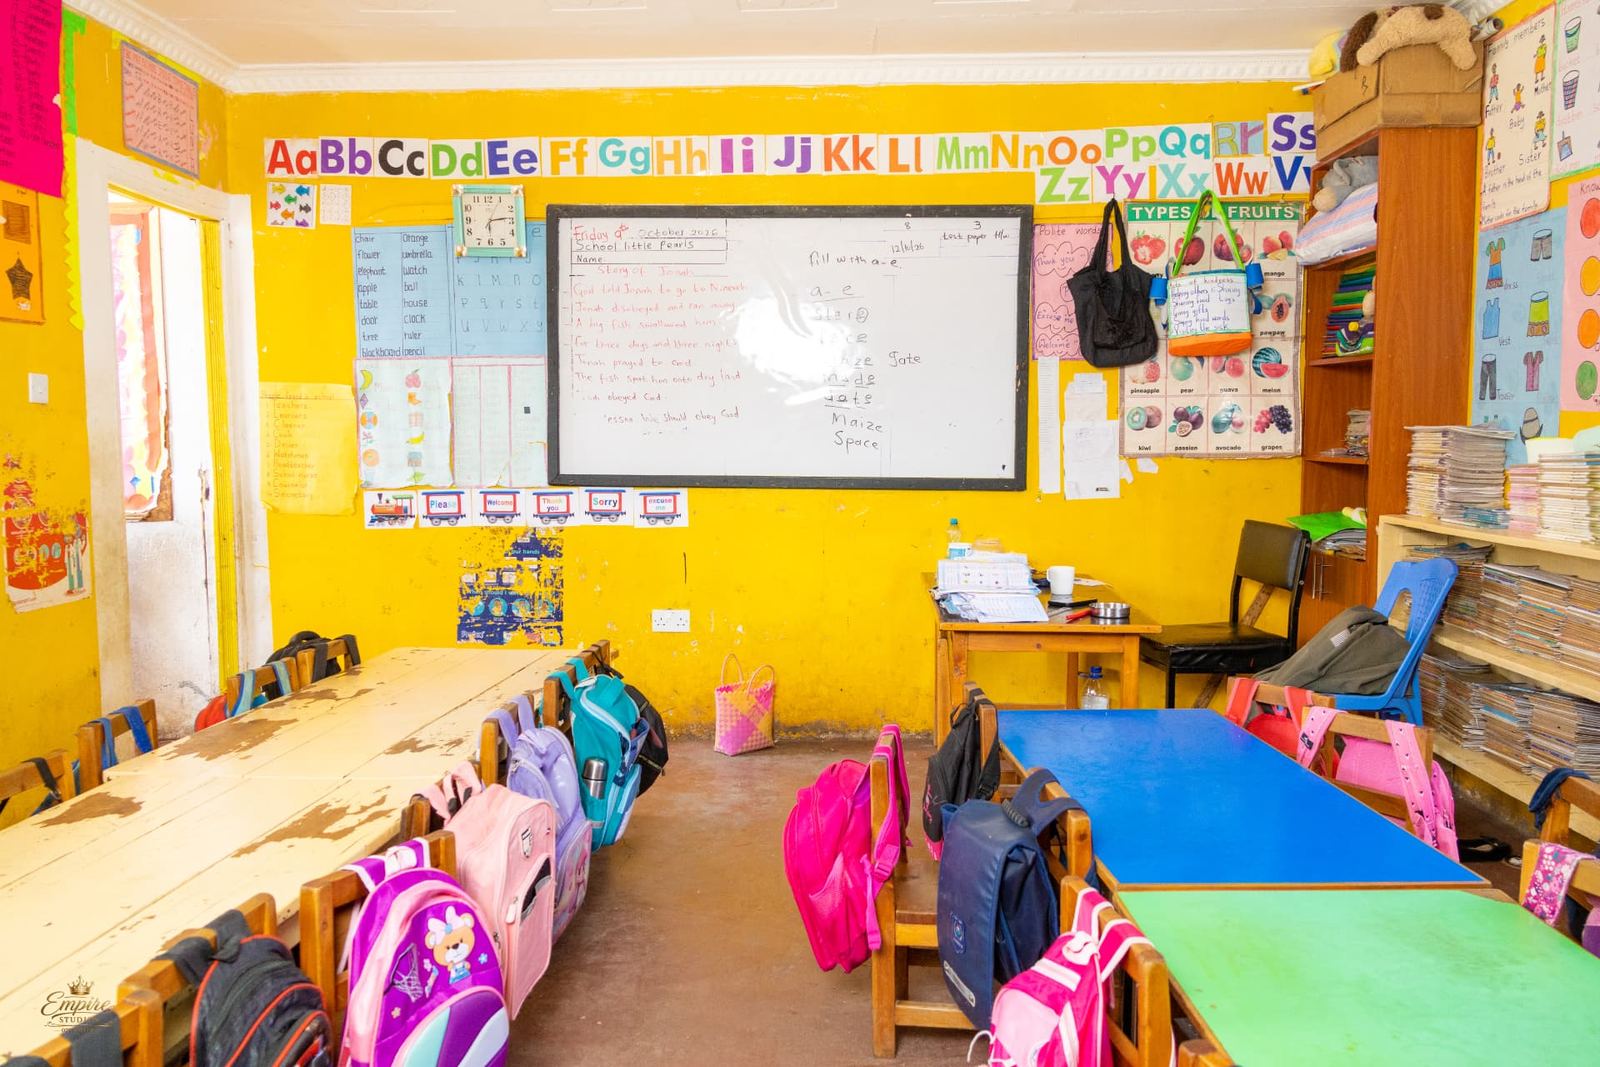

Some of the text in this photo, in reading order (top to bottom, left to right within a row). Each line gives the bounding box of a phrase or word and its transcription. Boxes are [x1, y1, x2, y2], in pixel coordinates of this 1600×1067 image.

[267, 139, 317, 175] Aa
[320, 138, 372, 176] Bb
[378, 139, 425, 176] Cc
[431, 141, 482, 177] Dd
[487, 140, 538, 176] Ee
[550, 138, 588, 175] Ff
[599, 138, 650, 175] Gg
[656, 138, 707, 175] Hh
[720, 137, 754, 173] Ii
[773, 136, 811, 173] Jj
[823, 135, 876, 171] Kk
[889, 136, 923, 172] Ll
[936, 136, 989, 170] Mm
[991, 134, 1044, 169] Nn
[1048, 136, 1102, 165] Oo
[1105, 128, 1157, 162] Pp
[1159, 126, 1211, 160] Qq
[1215, 122, 1263, 155] Rr
[1519, 152, 1541, 165] Sister
[1039, 167, 1090, 202] Zz
[1096, 164, 1146, 199] Yy
[1158, 163, 1210, 198] Xx
[1215, 162, 1268, 195] Ww
[464, 204, 514, 213] 10 2
[1132, 206, 1191, 220] TYPES
[1228, 206, 1294, 219] FRUITS
[508, 217, 514, 225] 3
[974, 220, 982, 230] 3
[467, 228, 514, 237] 8 4
[531, 227, 542, 237] e
[573, 225, 608, 242] Friday
[639, 228, 684, 237] October
[1039, 225, 1100, 236] Polite words
[355, 234, 375, 243] chair
[403, 234, 429, 246] Orange
[476, 238, 506, 246] 7 6 5
[576, 240, 617, 251] School
[624, 240, 652, 250] little
[357, 251, 380, 259] flower
[402, 250, 432, 259] umbrella
[577, 255, 603, 263] Name
[836, 256, 867, 265] with
[358, 266, 386, 279] elephant
[403, 266, 427, 275] watch
[598, 265, 629, 277] Story
[358, 283, 377, 296] apple
[404, 283, 417, 292] ball
[573, 283, 594, 297] God
[360, 301, 378, 309] table
[404, 299, 428, 307] house
[361, 316, 378, 325] door
[404, 315, 426, 324] clock
[576, 318, 582, 327] A
[362, 332, 379, 341] tree
[404, 332, 422, 340] ruler
[362, 348, 401, 357] blackboard
[404, 347, 425, 357] pencil
[1130, 387, 1160, 395] pineapple
[832, 412, 883, 433] Maize
[834, 431, 879, 454] Space
[592, 497, 618, 507] Sorry
